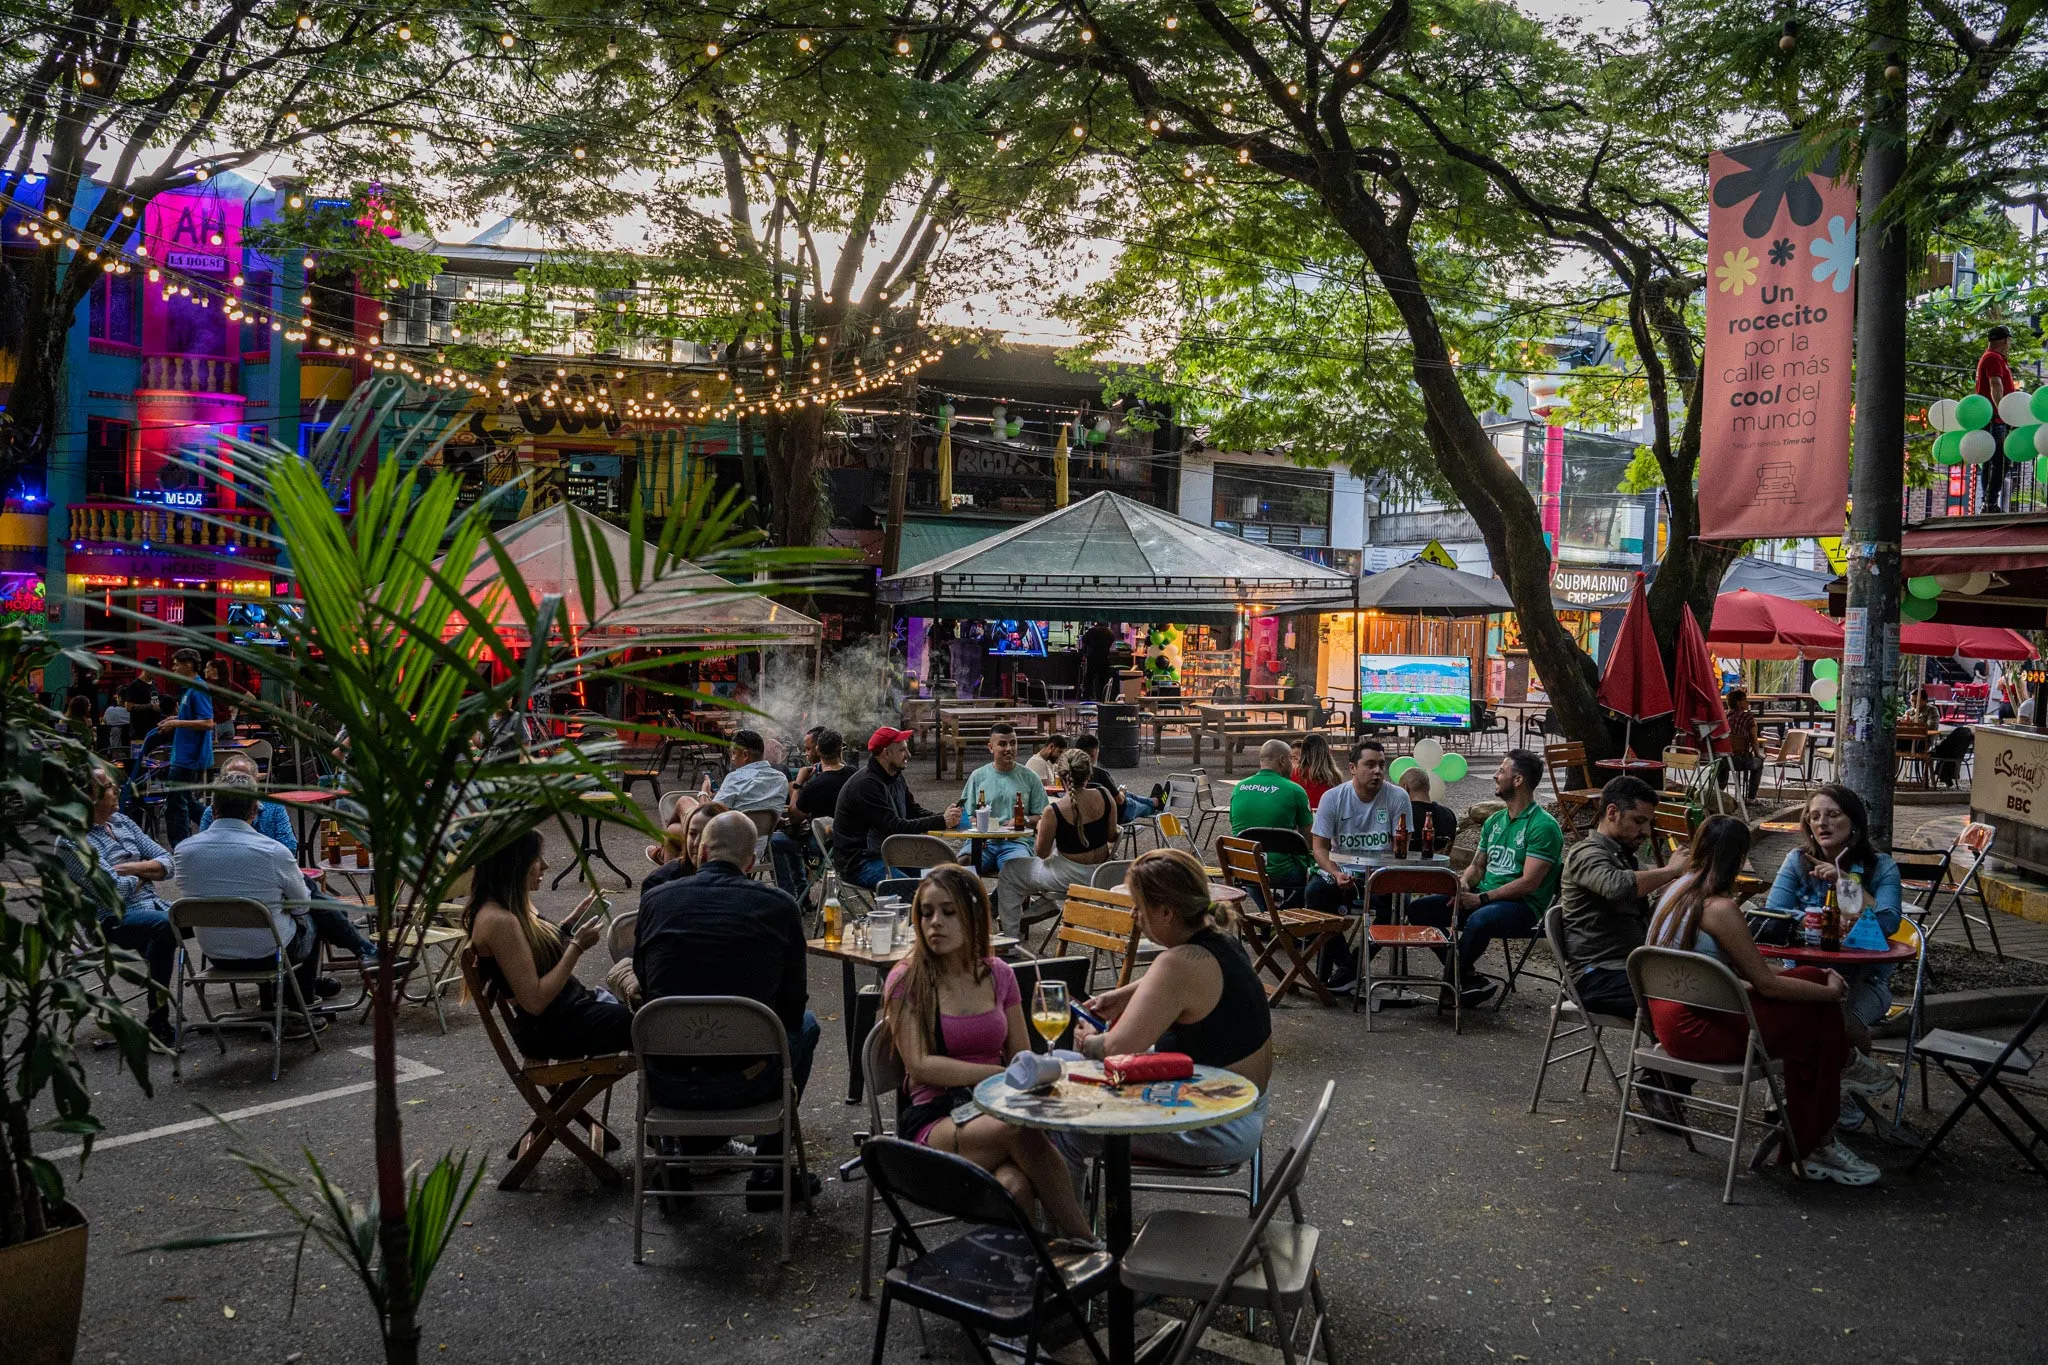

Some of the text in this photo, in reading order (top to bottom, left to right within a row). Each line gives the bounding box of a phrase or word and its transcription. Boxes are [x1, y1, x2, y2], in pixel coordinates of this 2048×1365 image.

[187, 257, 223, 268] HOUSE
[1761, 285, 1794, 304] Un
[1729, 305, 1827, 334] rocecito
[1744, 332, 1809, 360] por la
[1723, 354, 1830, 384] calle más
[1730, 380, 1821, 407] cool del
[1733, 408, 1817, 432] mundo
[1783, 438, 1800, 446] Time
[130, 560, 216, 575] LA HOUSE
[1555, 574, 1627, 592] SUBMARINO
[5, 600, 45, 610] HOUSE
[1994, 749, 2037, 784] Social
[2007, 795, 2032, 814] BBC
